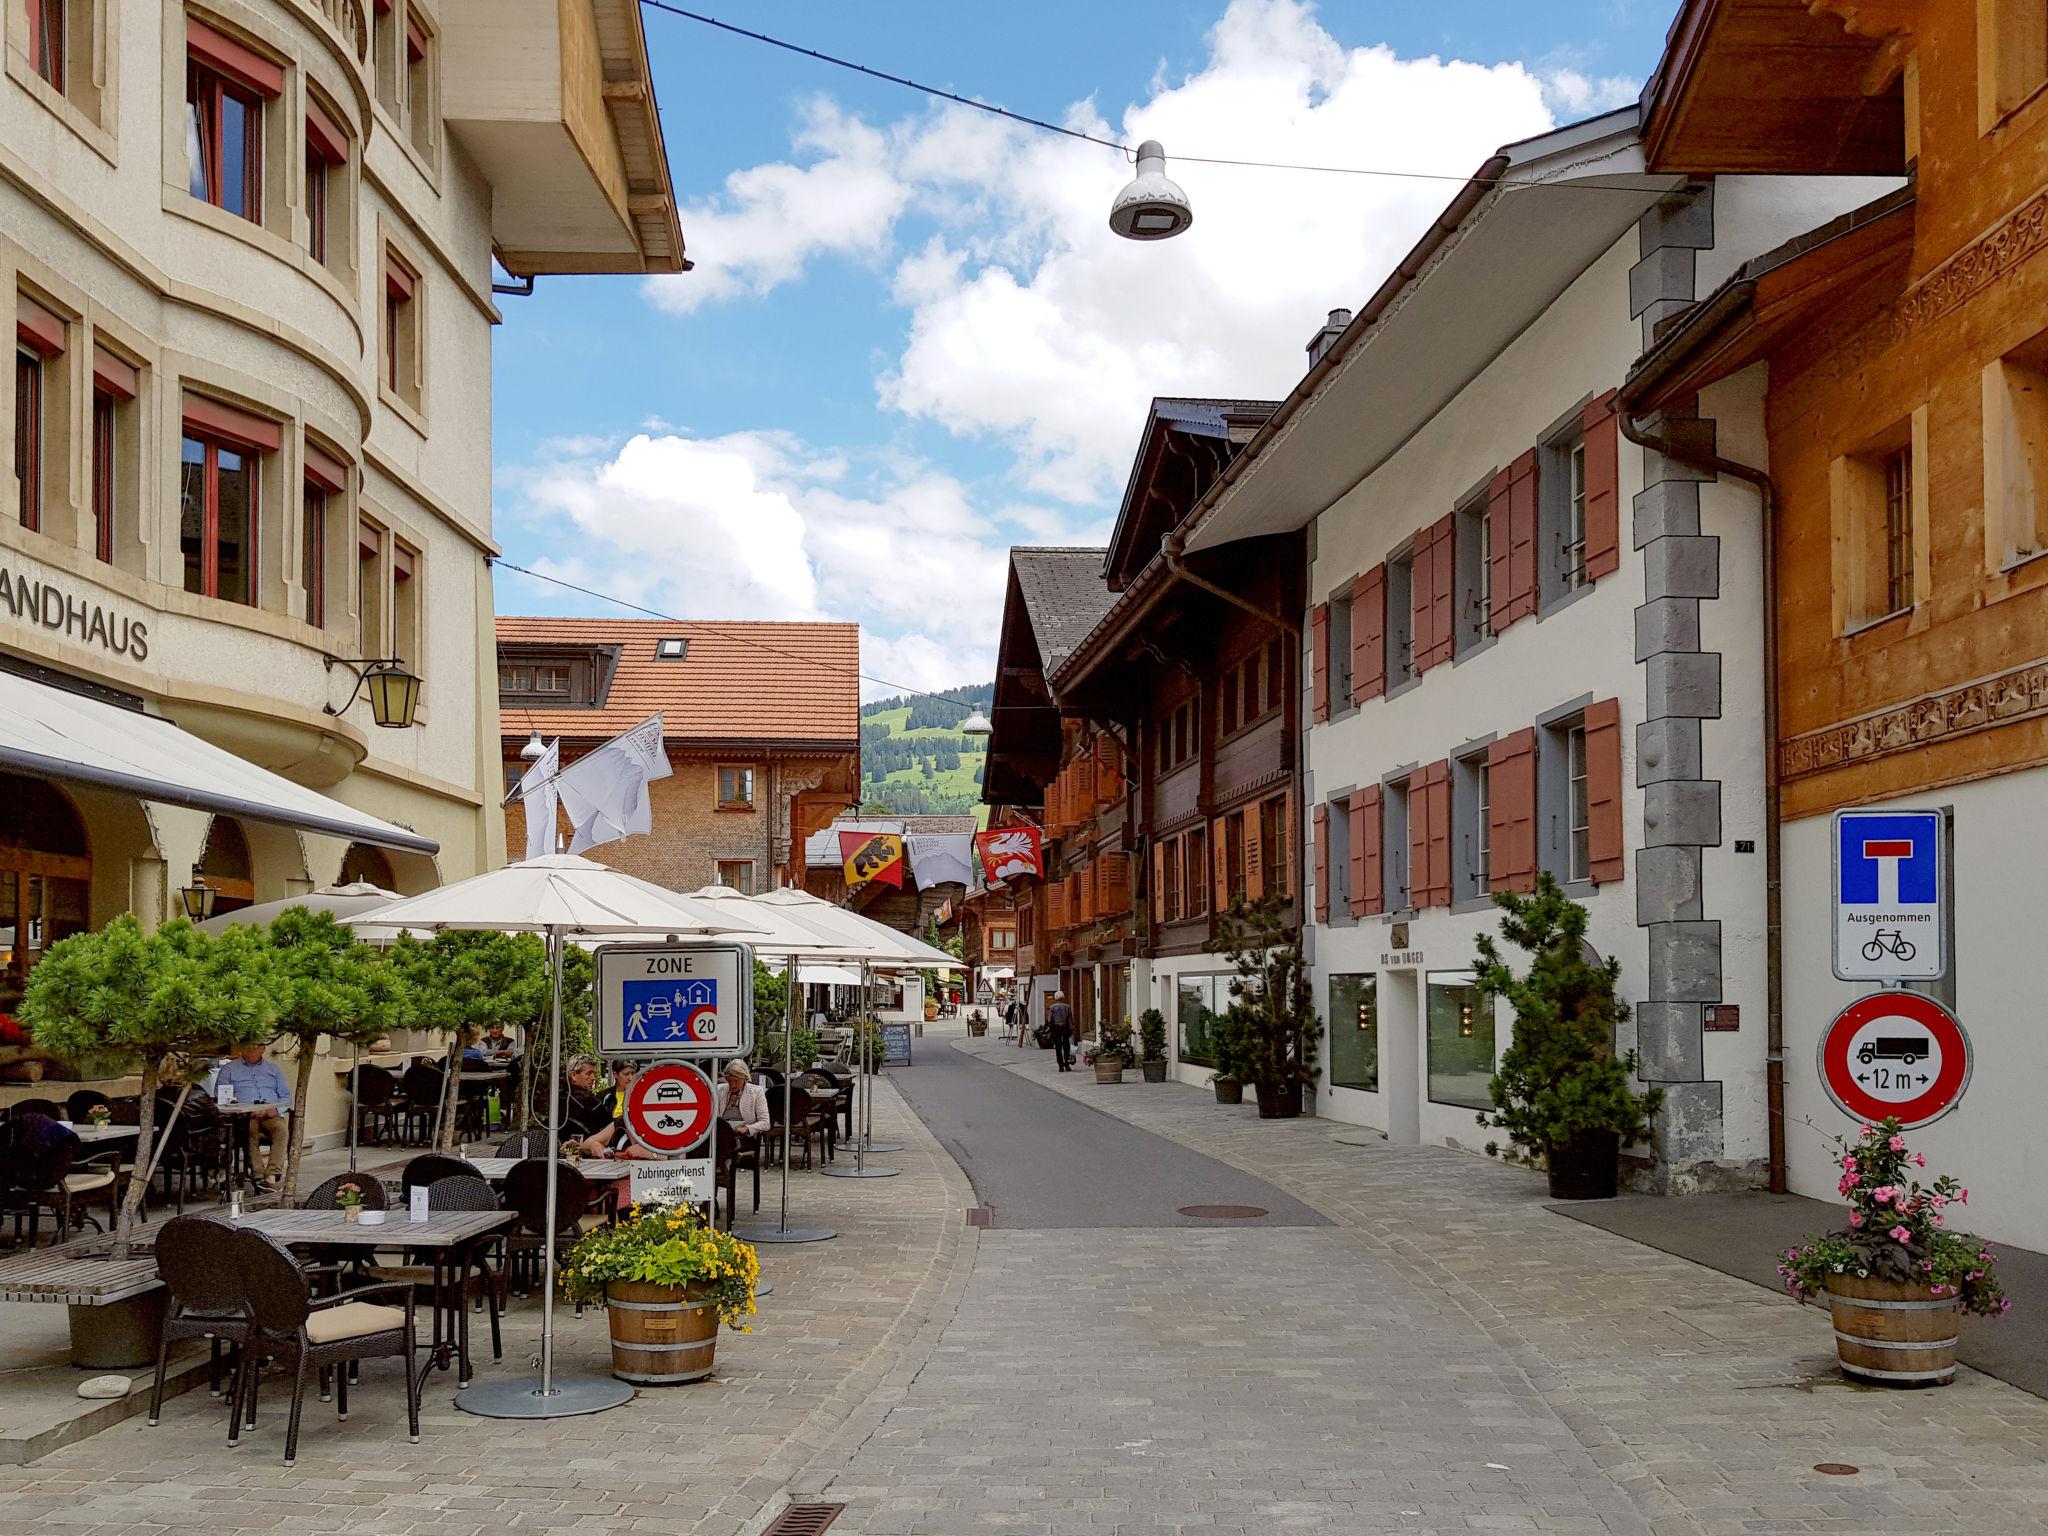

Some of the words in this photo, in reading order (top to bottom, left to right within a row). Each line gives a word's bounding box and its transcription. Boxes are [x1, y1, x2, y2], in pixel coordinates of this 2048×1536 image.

[0, 568, 148, 661] ANDHAUS
[1847, 912, 1931, 925] Ausgenommen
[646, 957, 693, 974] ZONE
[698, 1019, 716, 1034] 20
[1872, 1068, 1890, 1089] 12
[1896, 1073, 1911, 1090] m
[637, 1165, 705, 1181] Zubringerdienst
